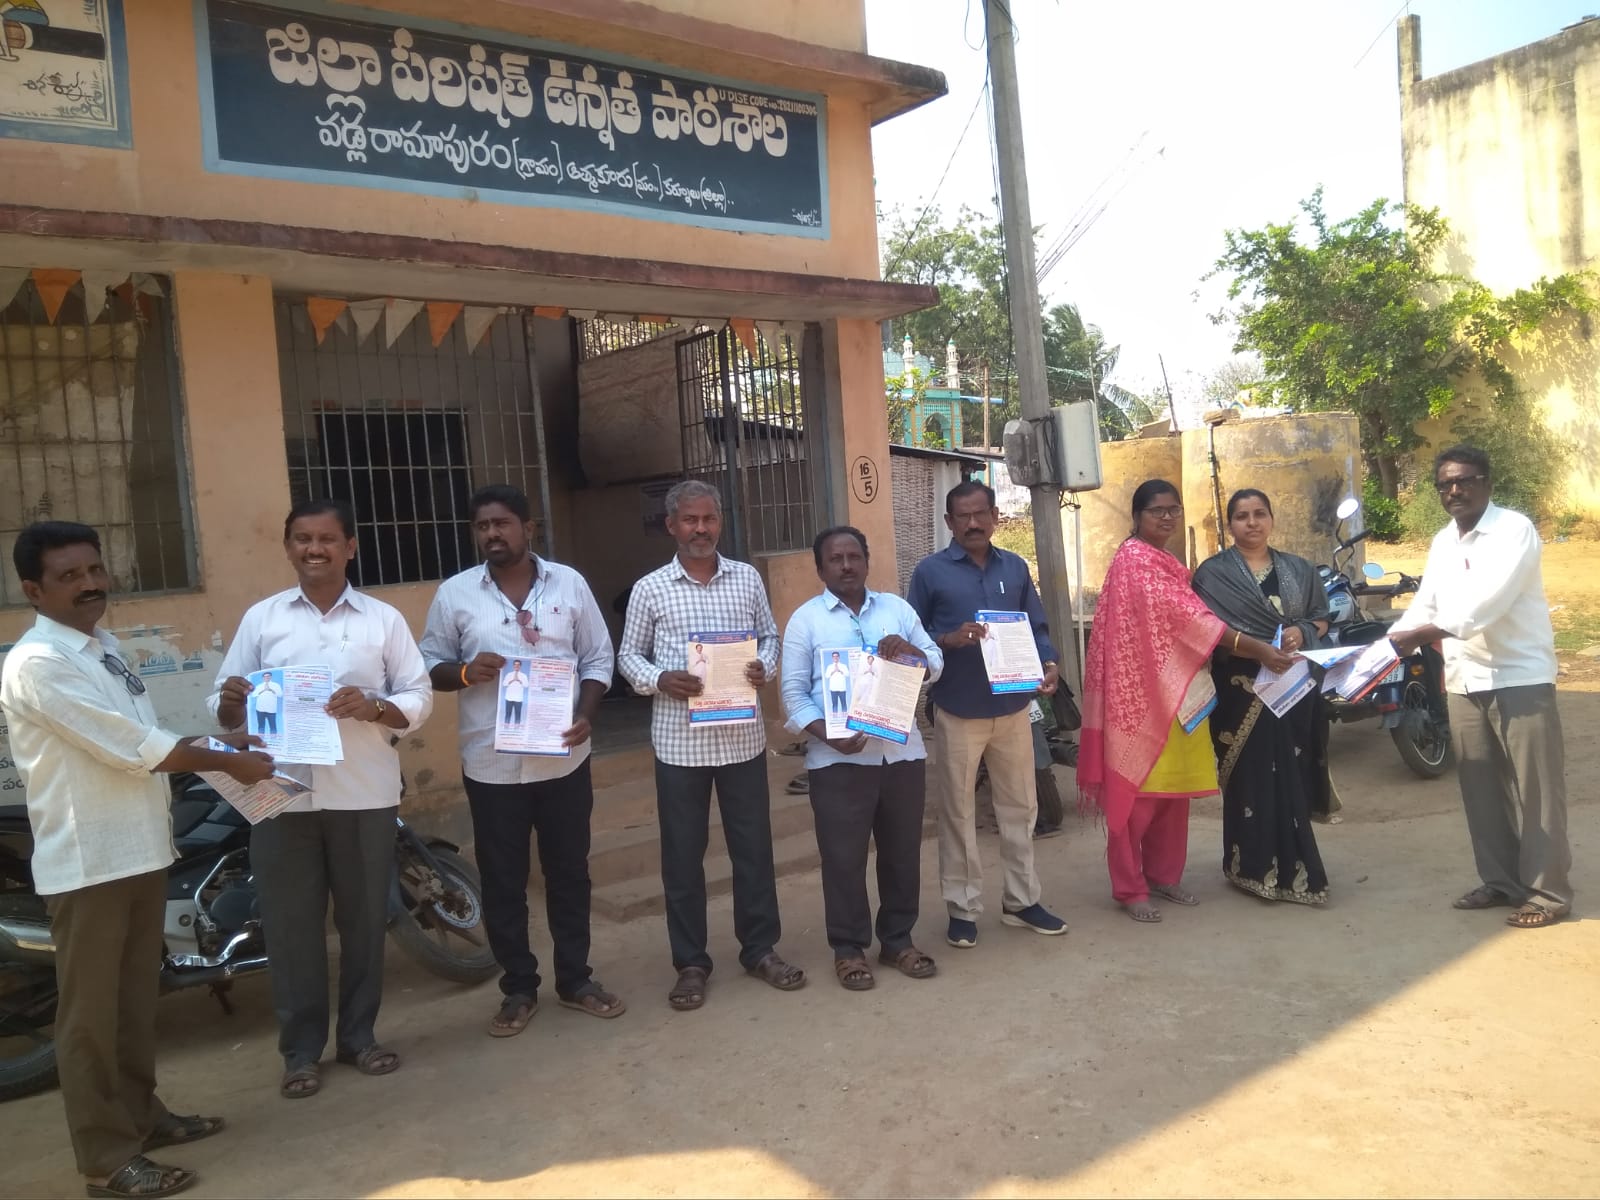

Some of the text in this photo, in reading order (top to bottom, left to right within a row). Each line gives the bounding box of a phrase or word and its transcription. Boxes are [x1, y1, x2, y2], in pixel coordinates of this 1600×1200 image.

[265, 22, 788, 158] జిల్లా పరిషత్ ఉన్నత పాఠశాల
[728, 91, 749, 105] DISE
[749, 95, 768, 108] CODE
[860, 462, 870, 476] 16
[864, 481, 873, 497] 5
